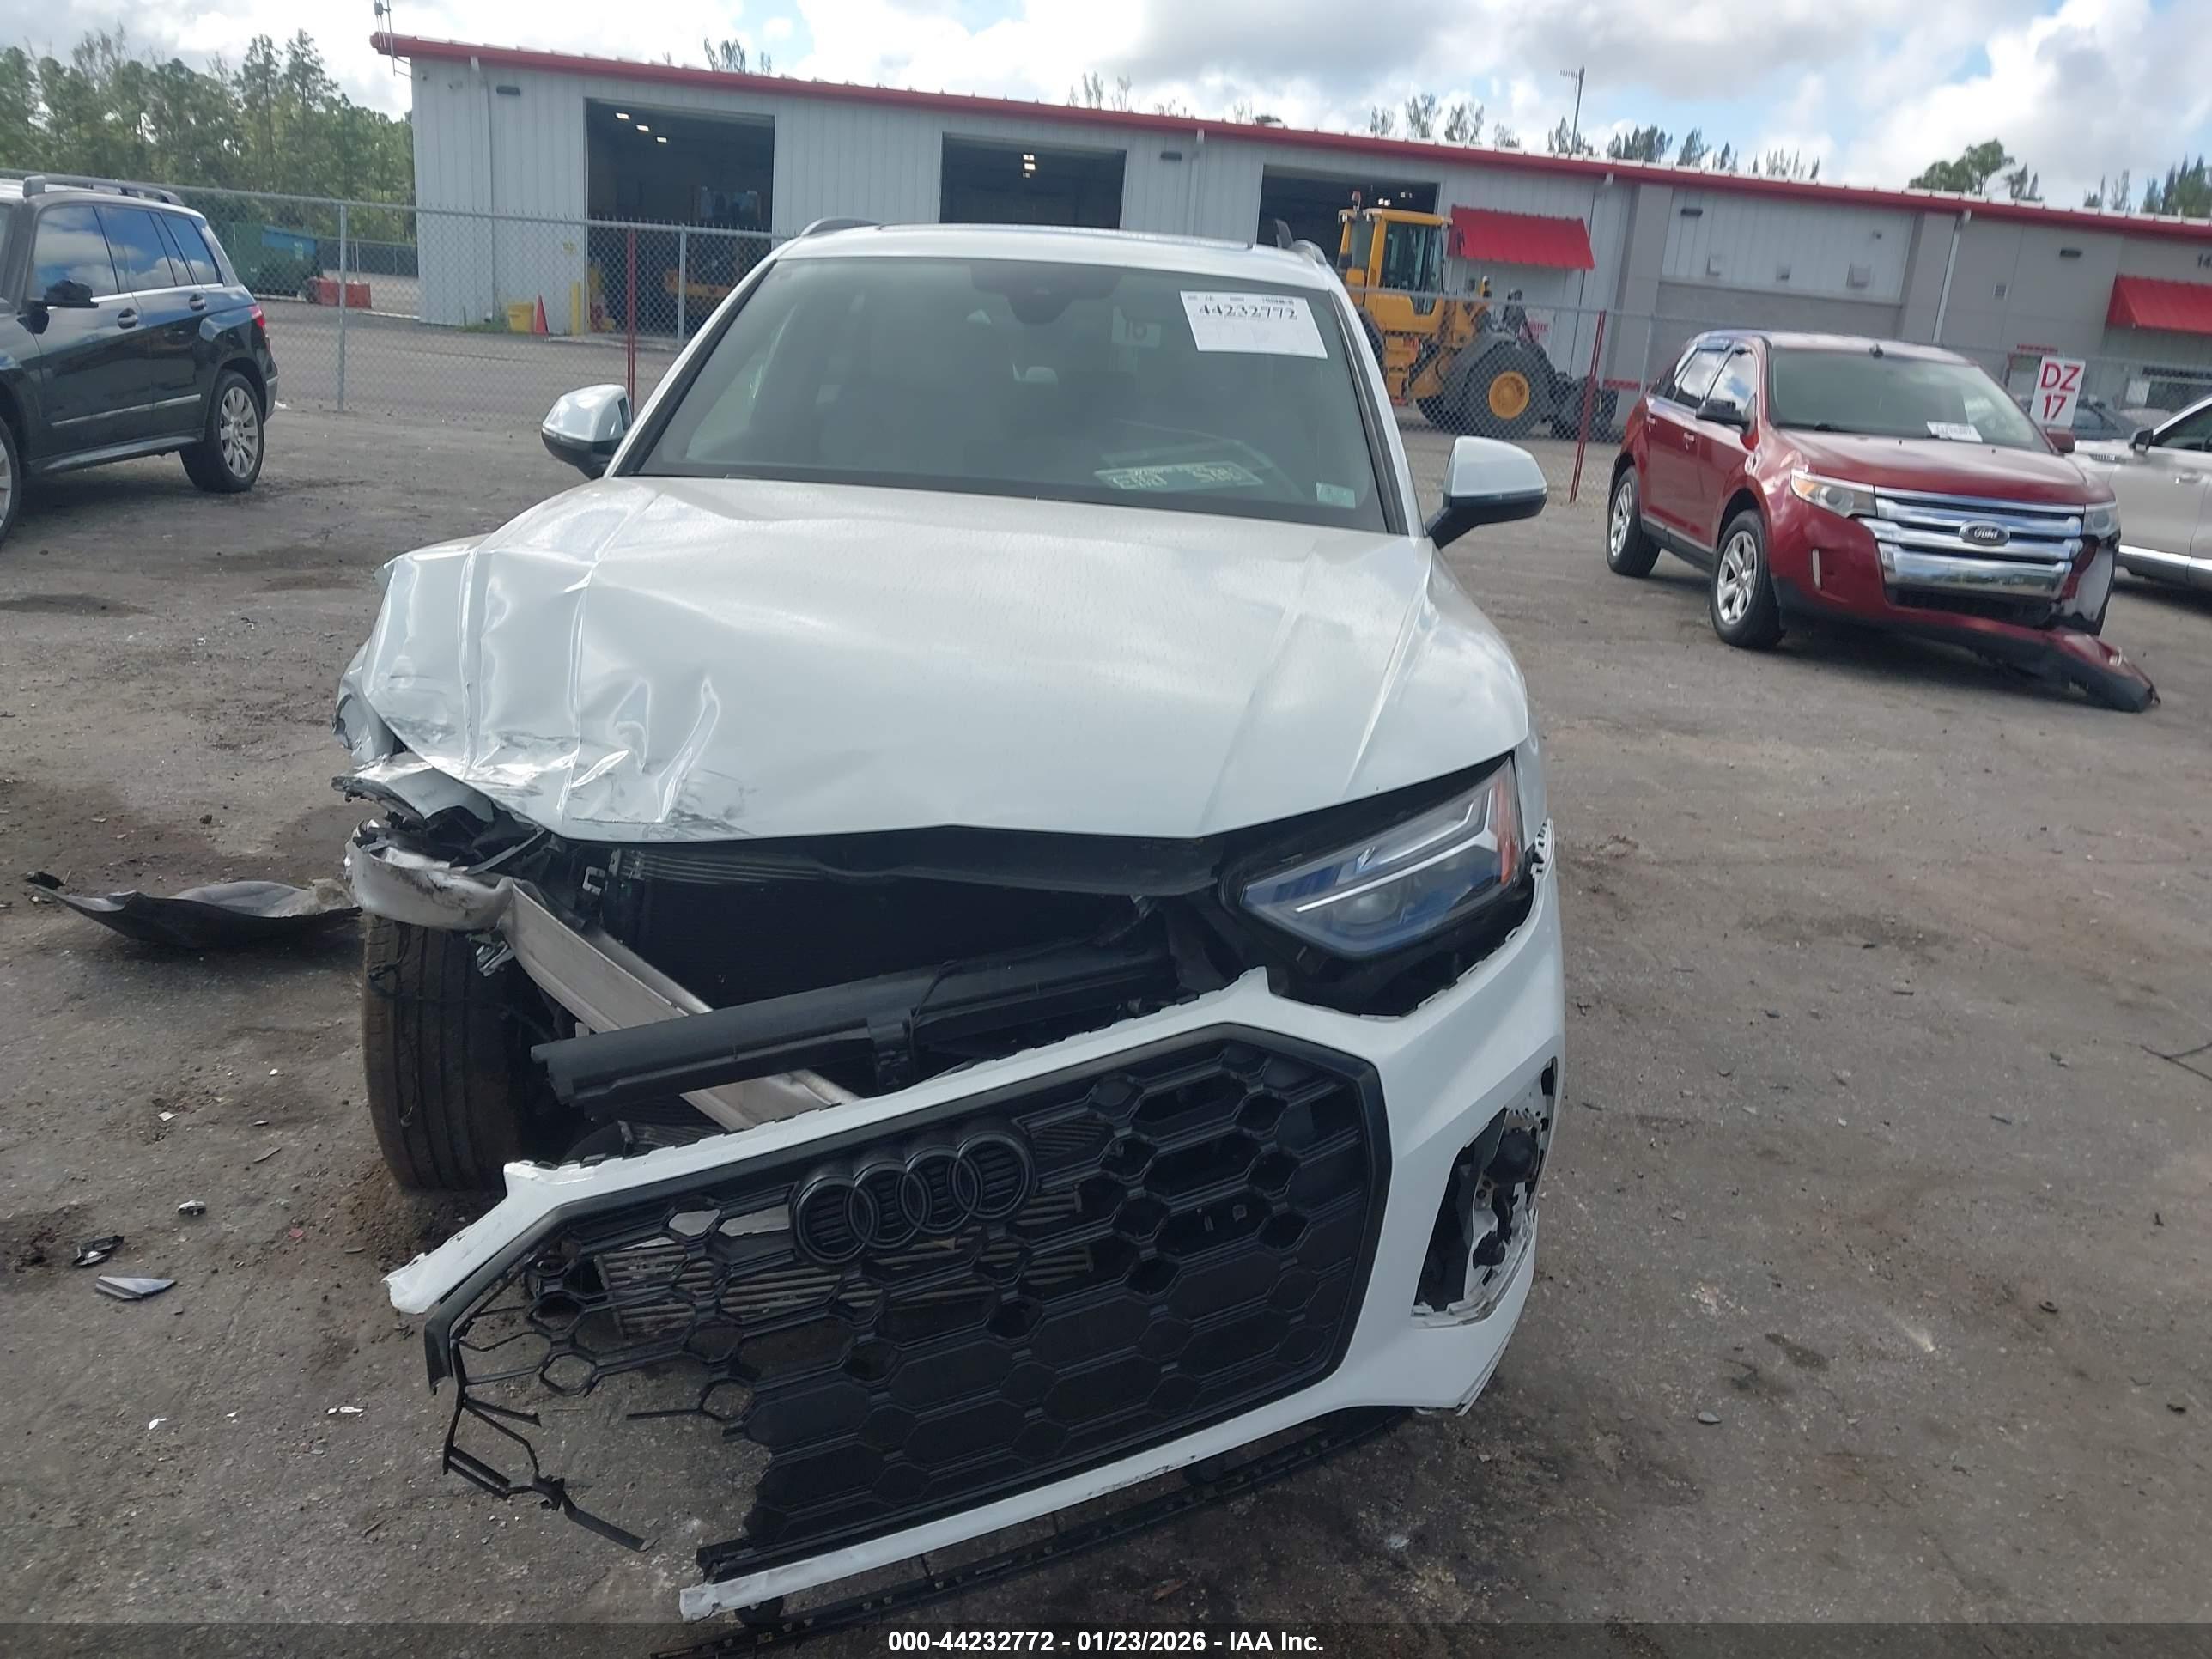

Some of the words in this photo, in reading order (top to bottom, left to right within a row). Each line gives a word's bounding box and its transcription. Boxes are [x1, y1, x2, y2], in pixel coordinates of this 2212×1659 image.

[1200, 303, 1298, 321] 44232772
[2041, 362, 2081, 392] DZ
[2044, 395, 2067, 419] 17
